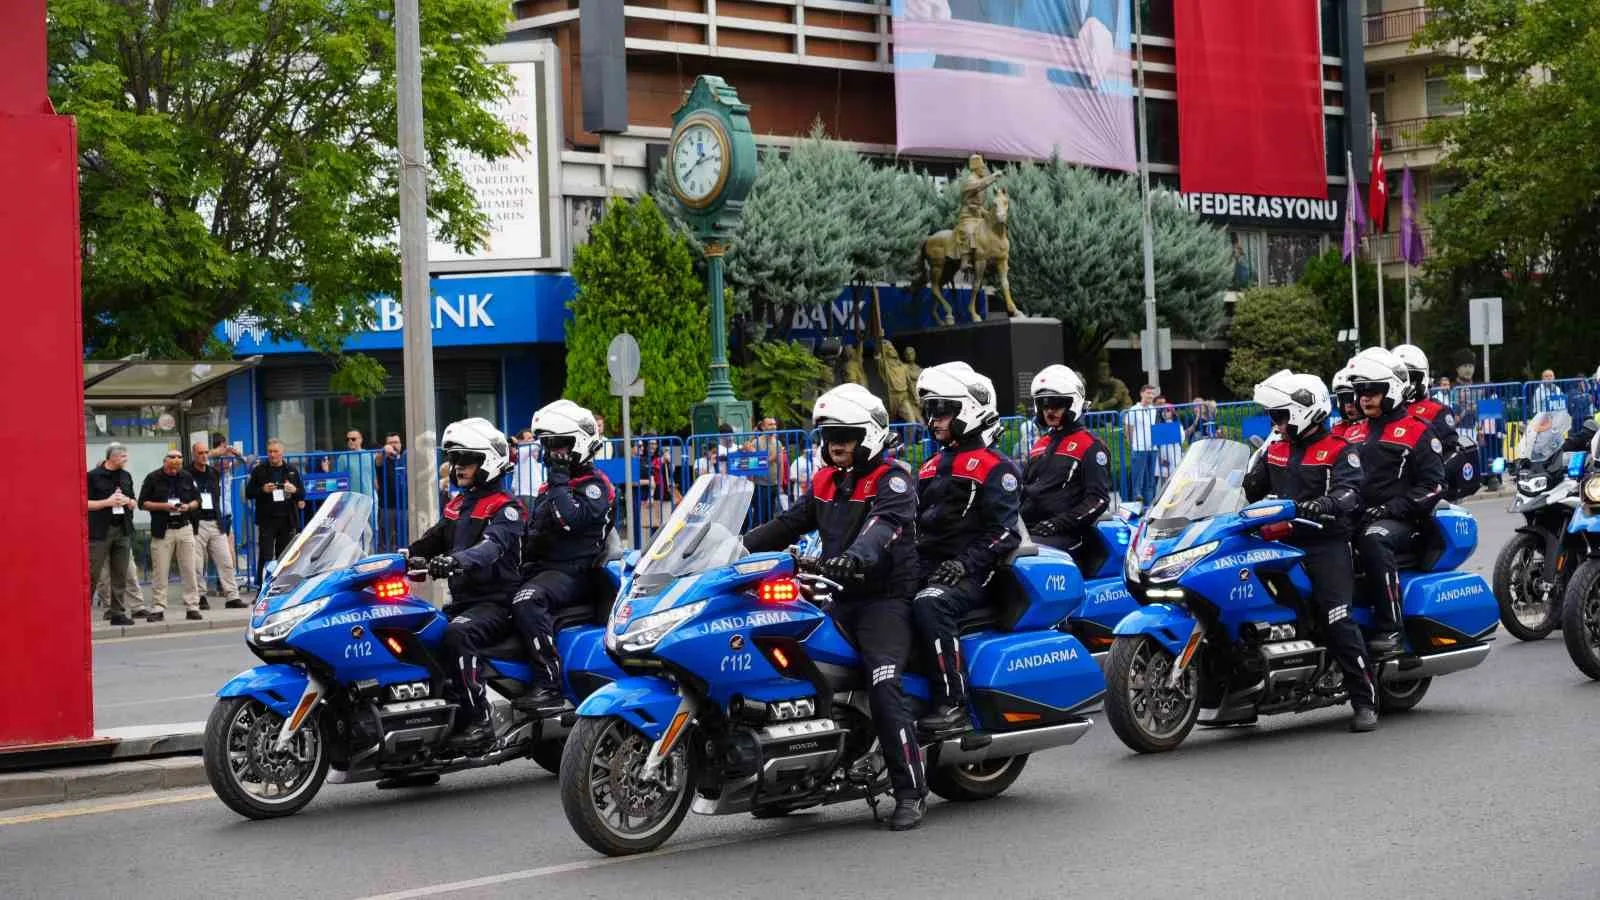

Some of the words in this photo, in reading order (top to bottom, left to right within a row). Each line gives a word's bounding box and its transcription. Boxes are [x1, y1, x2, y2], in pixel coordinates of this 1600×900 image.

[1153, 191, 1338, 221] NFEDERASYONU
[1213, 550, 1281, 569] JANDARMA
[1053, 575, 1066, 591] 112
[1238, 584, 1254, 600] 112
[1094, 589, 1132, 604] JANDAR
[1435, 584, 1484, 603] JANDARMA
[322, 605, 402, 627] JANDARMA
[700, 610, 792, 634] JANDARMA
[353, 641, 373, 657] 112
[731, 654, 752, 671] 112
[1006, 647, 1078, 672] JANDARMA
